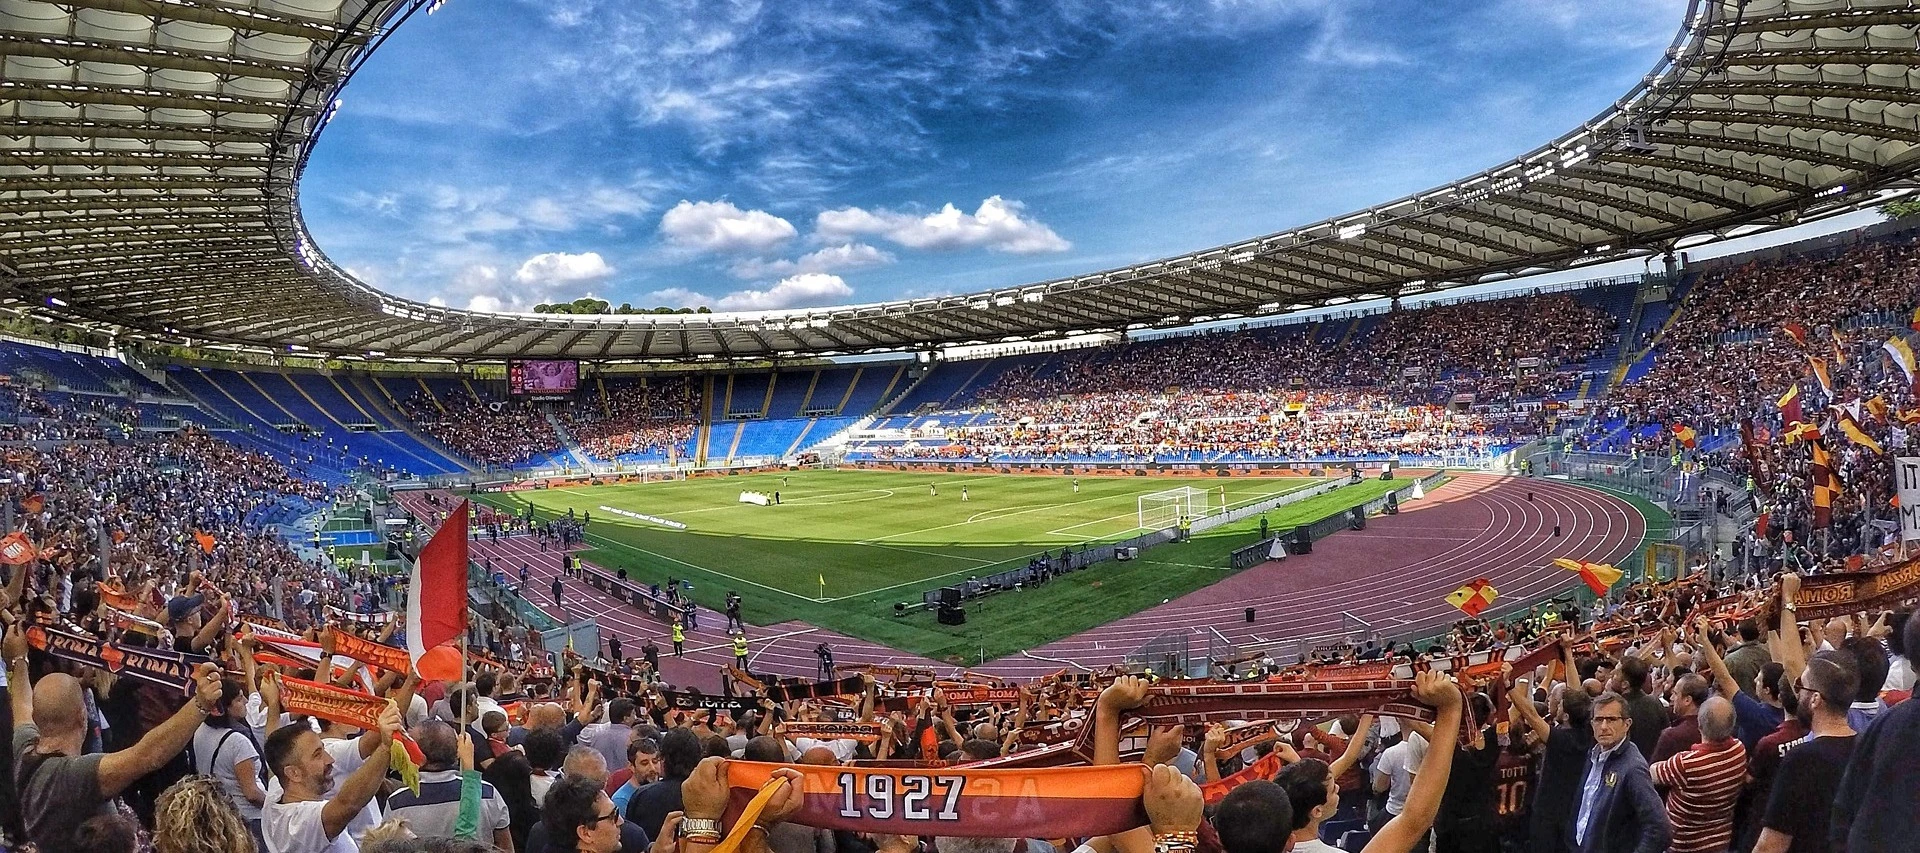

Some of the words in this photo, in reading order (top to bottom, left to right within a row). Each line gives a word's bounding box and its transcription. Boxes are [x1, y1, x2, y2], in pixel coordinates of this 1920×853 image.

[989, 690, 1019, 699] ROMA
[1500, 766, 1528, 779] TOTTI
[838, 772, 967, 821] 1927
[1497, 781, 1527, 815] 10
